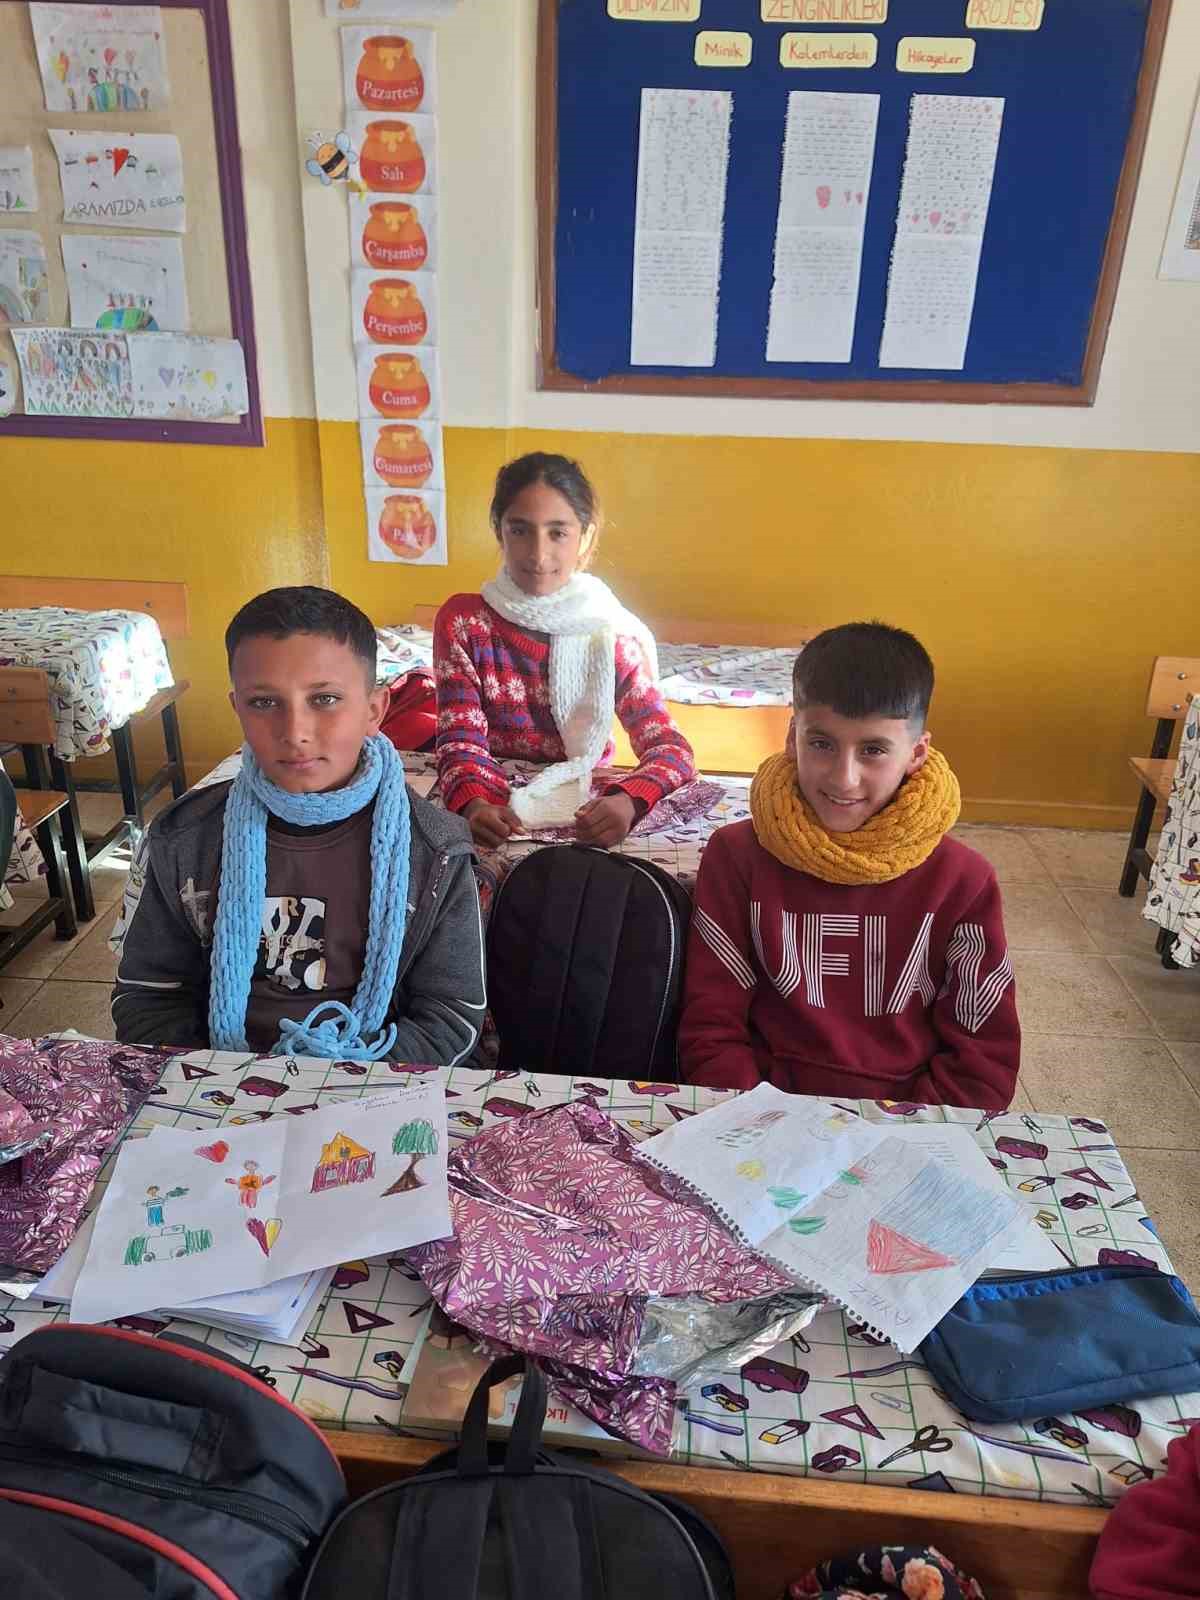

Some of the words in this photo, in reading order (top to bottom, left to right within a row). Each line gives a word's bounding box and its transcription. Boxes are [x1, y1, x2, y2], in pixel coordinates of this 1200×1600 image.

[704, 42, 744, 59] Minik
[362, 80, 420, 101] Pazartesi
[382, 390, 417, 406] Cuma
